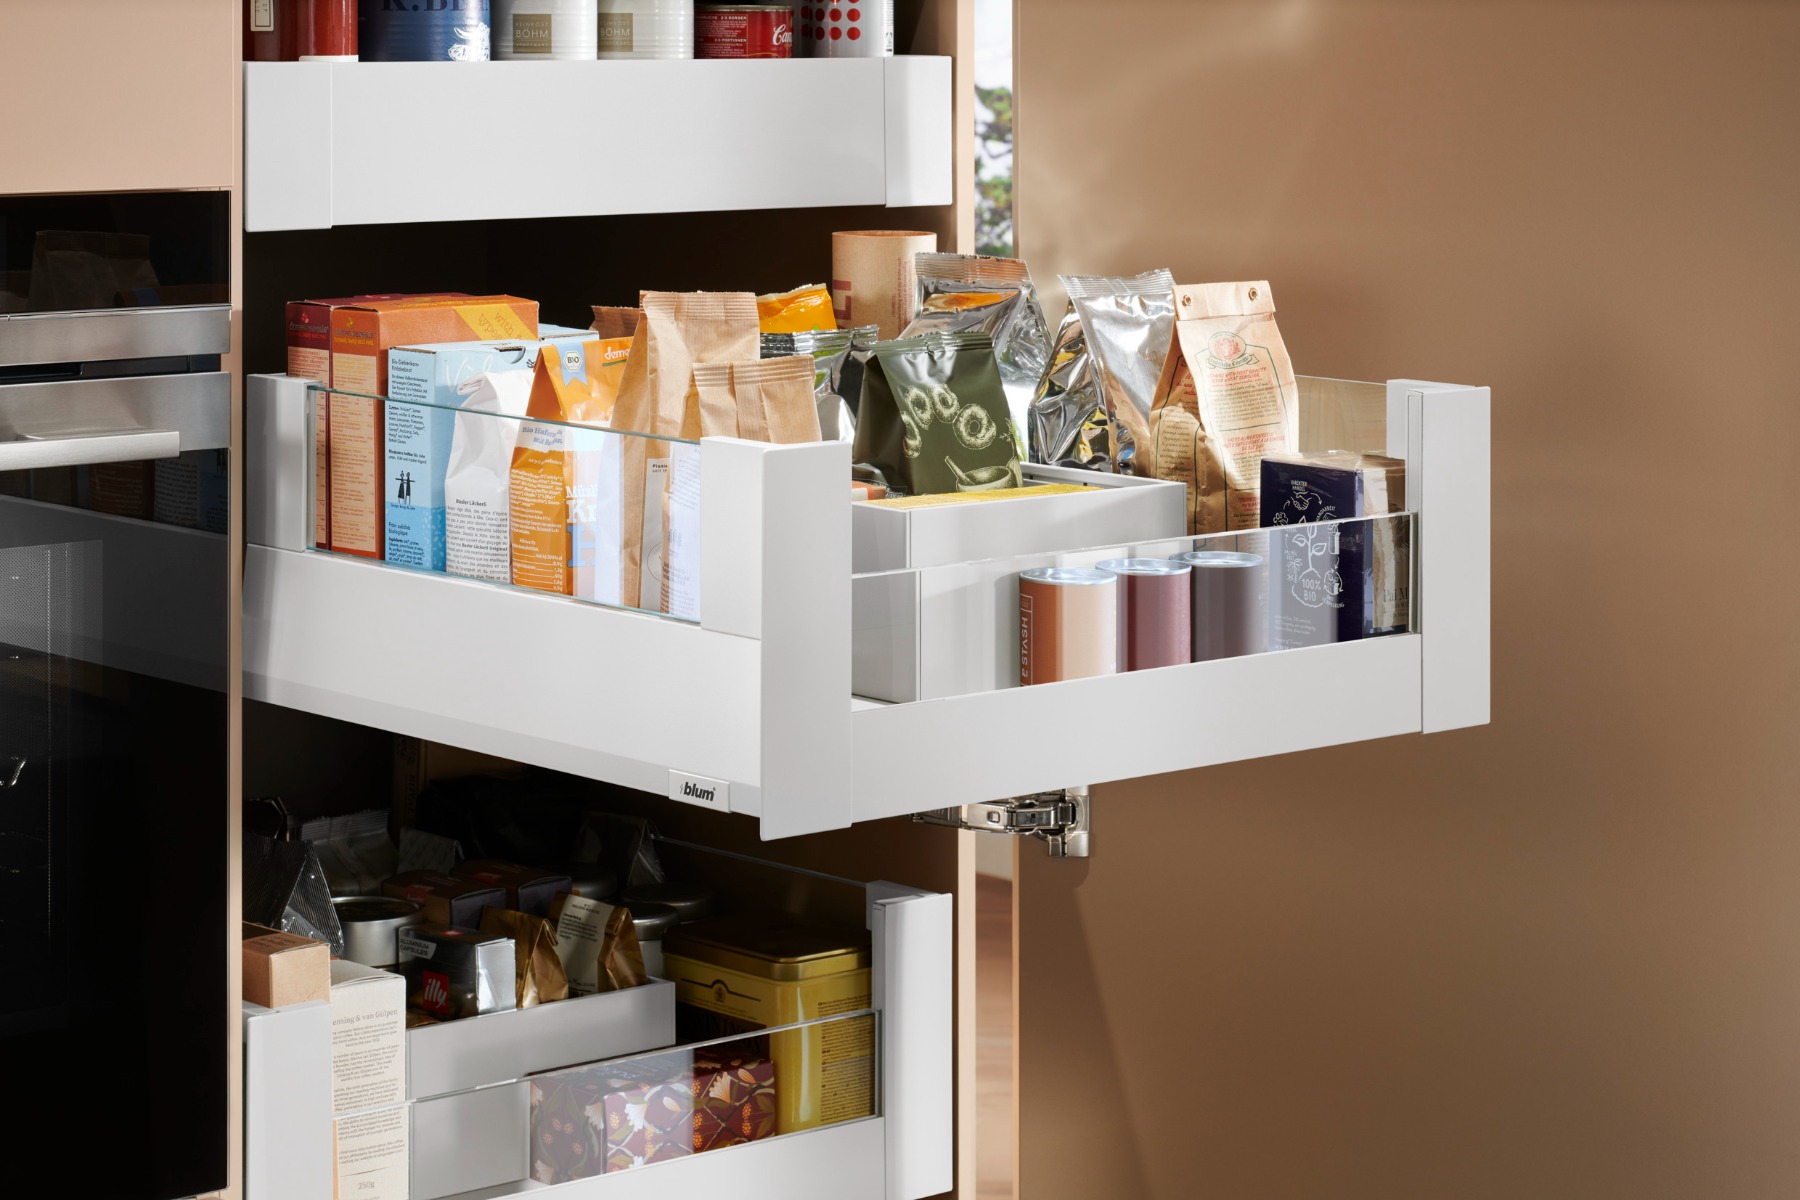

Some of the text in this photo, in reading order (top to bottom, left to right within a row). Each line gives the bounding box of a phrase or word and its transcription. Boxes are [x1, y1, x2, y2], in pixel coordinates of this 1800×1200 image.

[516, 28, 549, 38] BÖHM
[494, 311, 514, 340] with
[567, 356, 580, 364] BIO
[1301, 578, 1322, 591] 100%
[1303, 590, 1317, 602] BIO
[683, 781, 715, 802] blum
[400, 937, 429, 950] ALUMINIUM
[400, 944, 429, 957] CAPSULES
[424, 978, 448, 1009] illy
[332, 1015, 355, 1026] ensing
[356, 1014, 361, 1022] &
[357, 1180, 376, 1191] 250g
